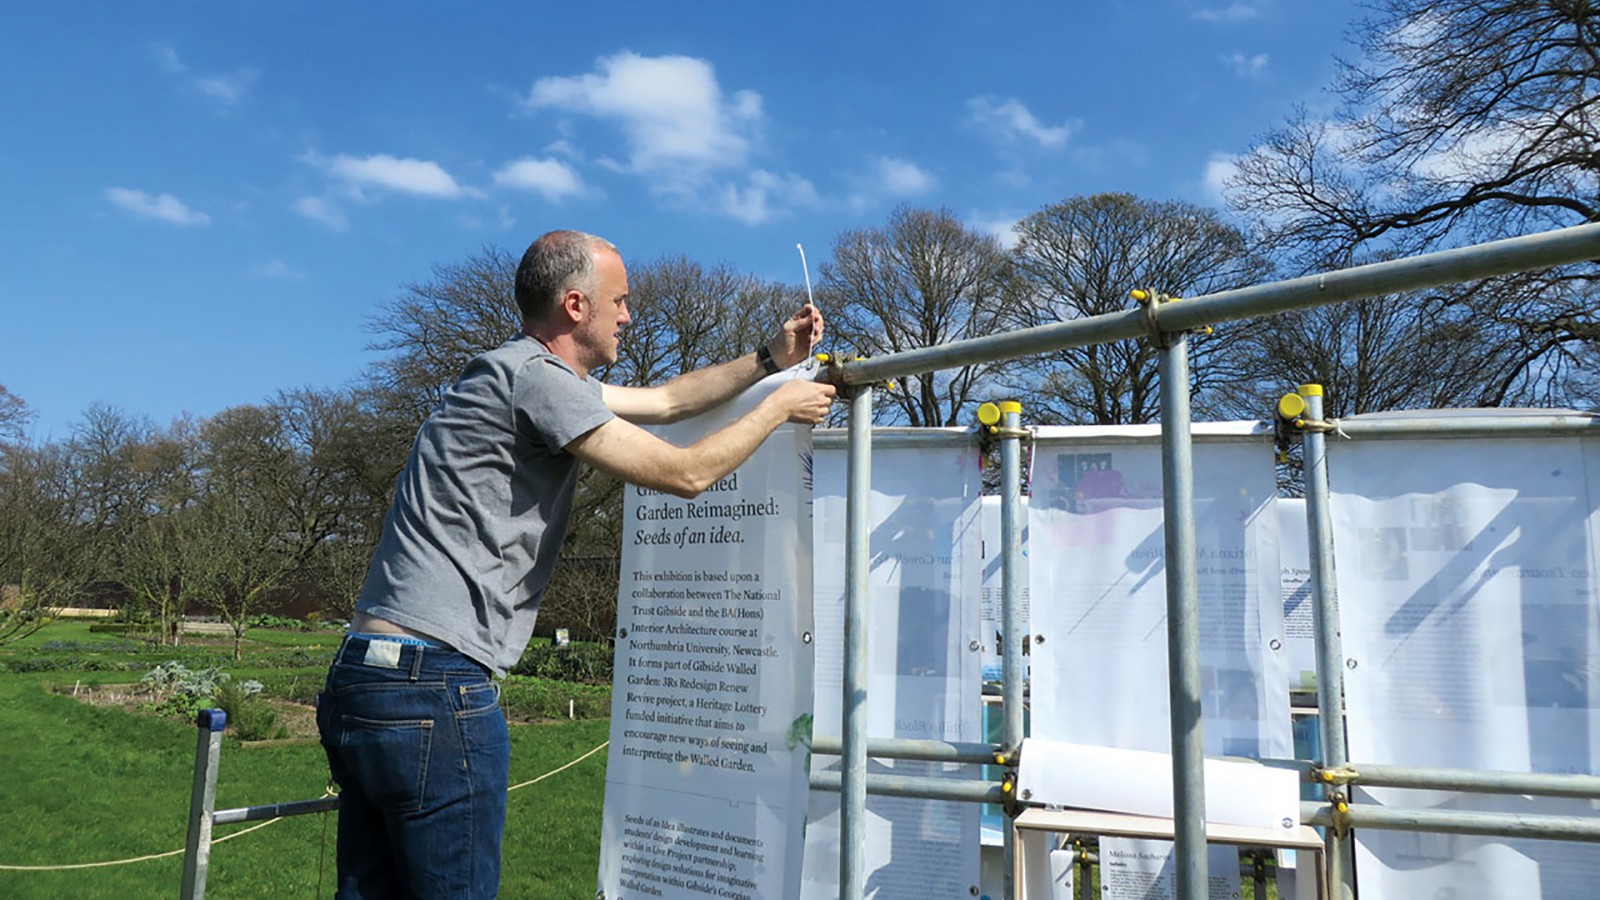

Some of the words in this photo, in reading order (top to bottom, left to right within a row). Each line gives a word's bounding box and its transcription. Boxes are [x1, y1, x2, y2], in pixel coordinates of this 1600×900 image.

[636, 502, 683, 520] Garden
[687, 497, 779, 520] Reimagined:
[634, 527, 671, 545] Seeds
[674, 526, 687, 548] of
[689, 532, 705, 544] an
[710, 525, 744, 543] idea.
[633, 571, 653, 581] This
[654, 570, 692, 581] exhibition
[694, 571, 702, 581] is
[703, 570, 728, 582] based
[730, 573, 752, 585] upon
[632, 589, 685, 600] collaboration
[686, 589, 722, 600] between
[724, 590, 742, 600] The
[743, 589, 781, 600] National
[632, 606, 655, 616] Trust
[656, 605, 687, 617] Gibside
[688, 606, 703, 617] and
[705, 606, 719, 618] the
[721, 607, 764, 620] BA(Hons)
[631, 623, 664, 633] Interior
[665, 623, 717, 636] Architecture
[719, 628, 747, 637] course
[749, 628, 758, 638] at
[629, 640, 684, 652] Northumbria
[686, 643, 731, 657] University,
[733, 645, 779, 657] Newcastle.
[628, 657, 637, 667] It
[638, 657, 662, 668] forms
[664, 660, 681, 672] part
[682, 659, 692, 670] of
[692, 660, 725, 673] Gibside
[726, 662, 757, 675] Walled
[627, 674, 660, 686] Garden:
[662, 677, 678, 688] 3Rs
[679, 678, 717, 692] Redesign
[719, 682, 749, 693] Renew
[627, 692, 655, 704] Revive
[656, 695, 688, 707] project,
[696, 699, 733, 712] Heritage
[734, 702, 768, 717] Lottery
[625, 708, 656, 721] funded
[657, 712, 695, 726] initiative
[695, 715, 713, 728] that
[714, 719, 734, 730] aims
[736, 721, 745, 731] to
[624, 729, 667, 743] encourage
[668, 733, 686, 743] new
[688, 736, 710, 749] ways
[710, 736, 720, 747] of
[721, 738, 749, 753] seeing
[750, 742, 768, 754] and
[623, 745, 673, 762] interpreting
[675, 748, 689, 762] the
[690, 751, 720, 767] Walled
[720, 758, 756, 773] Garden.
